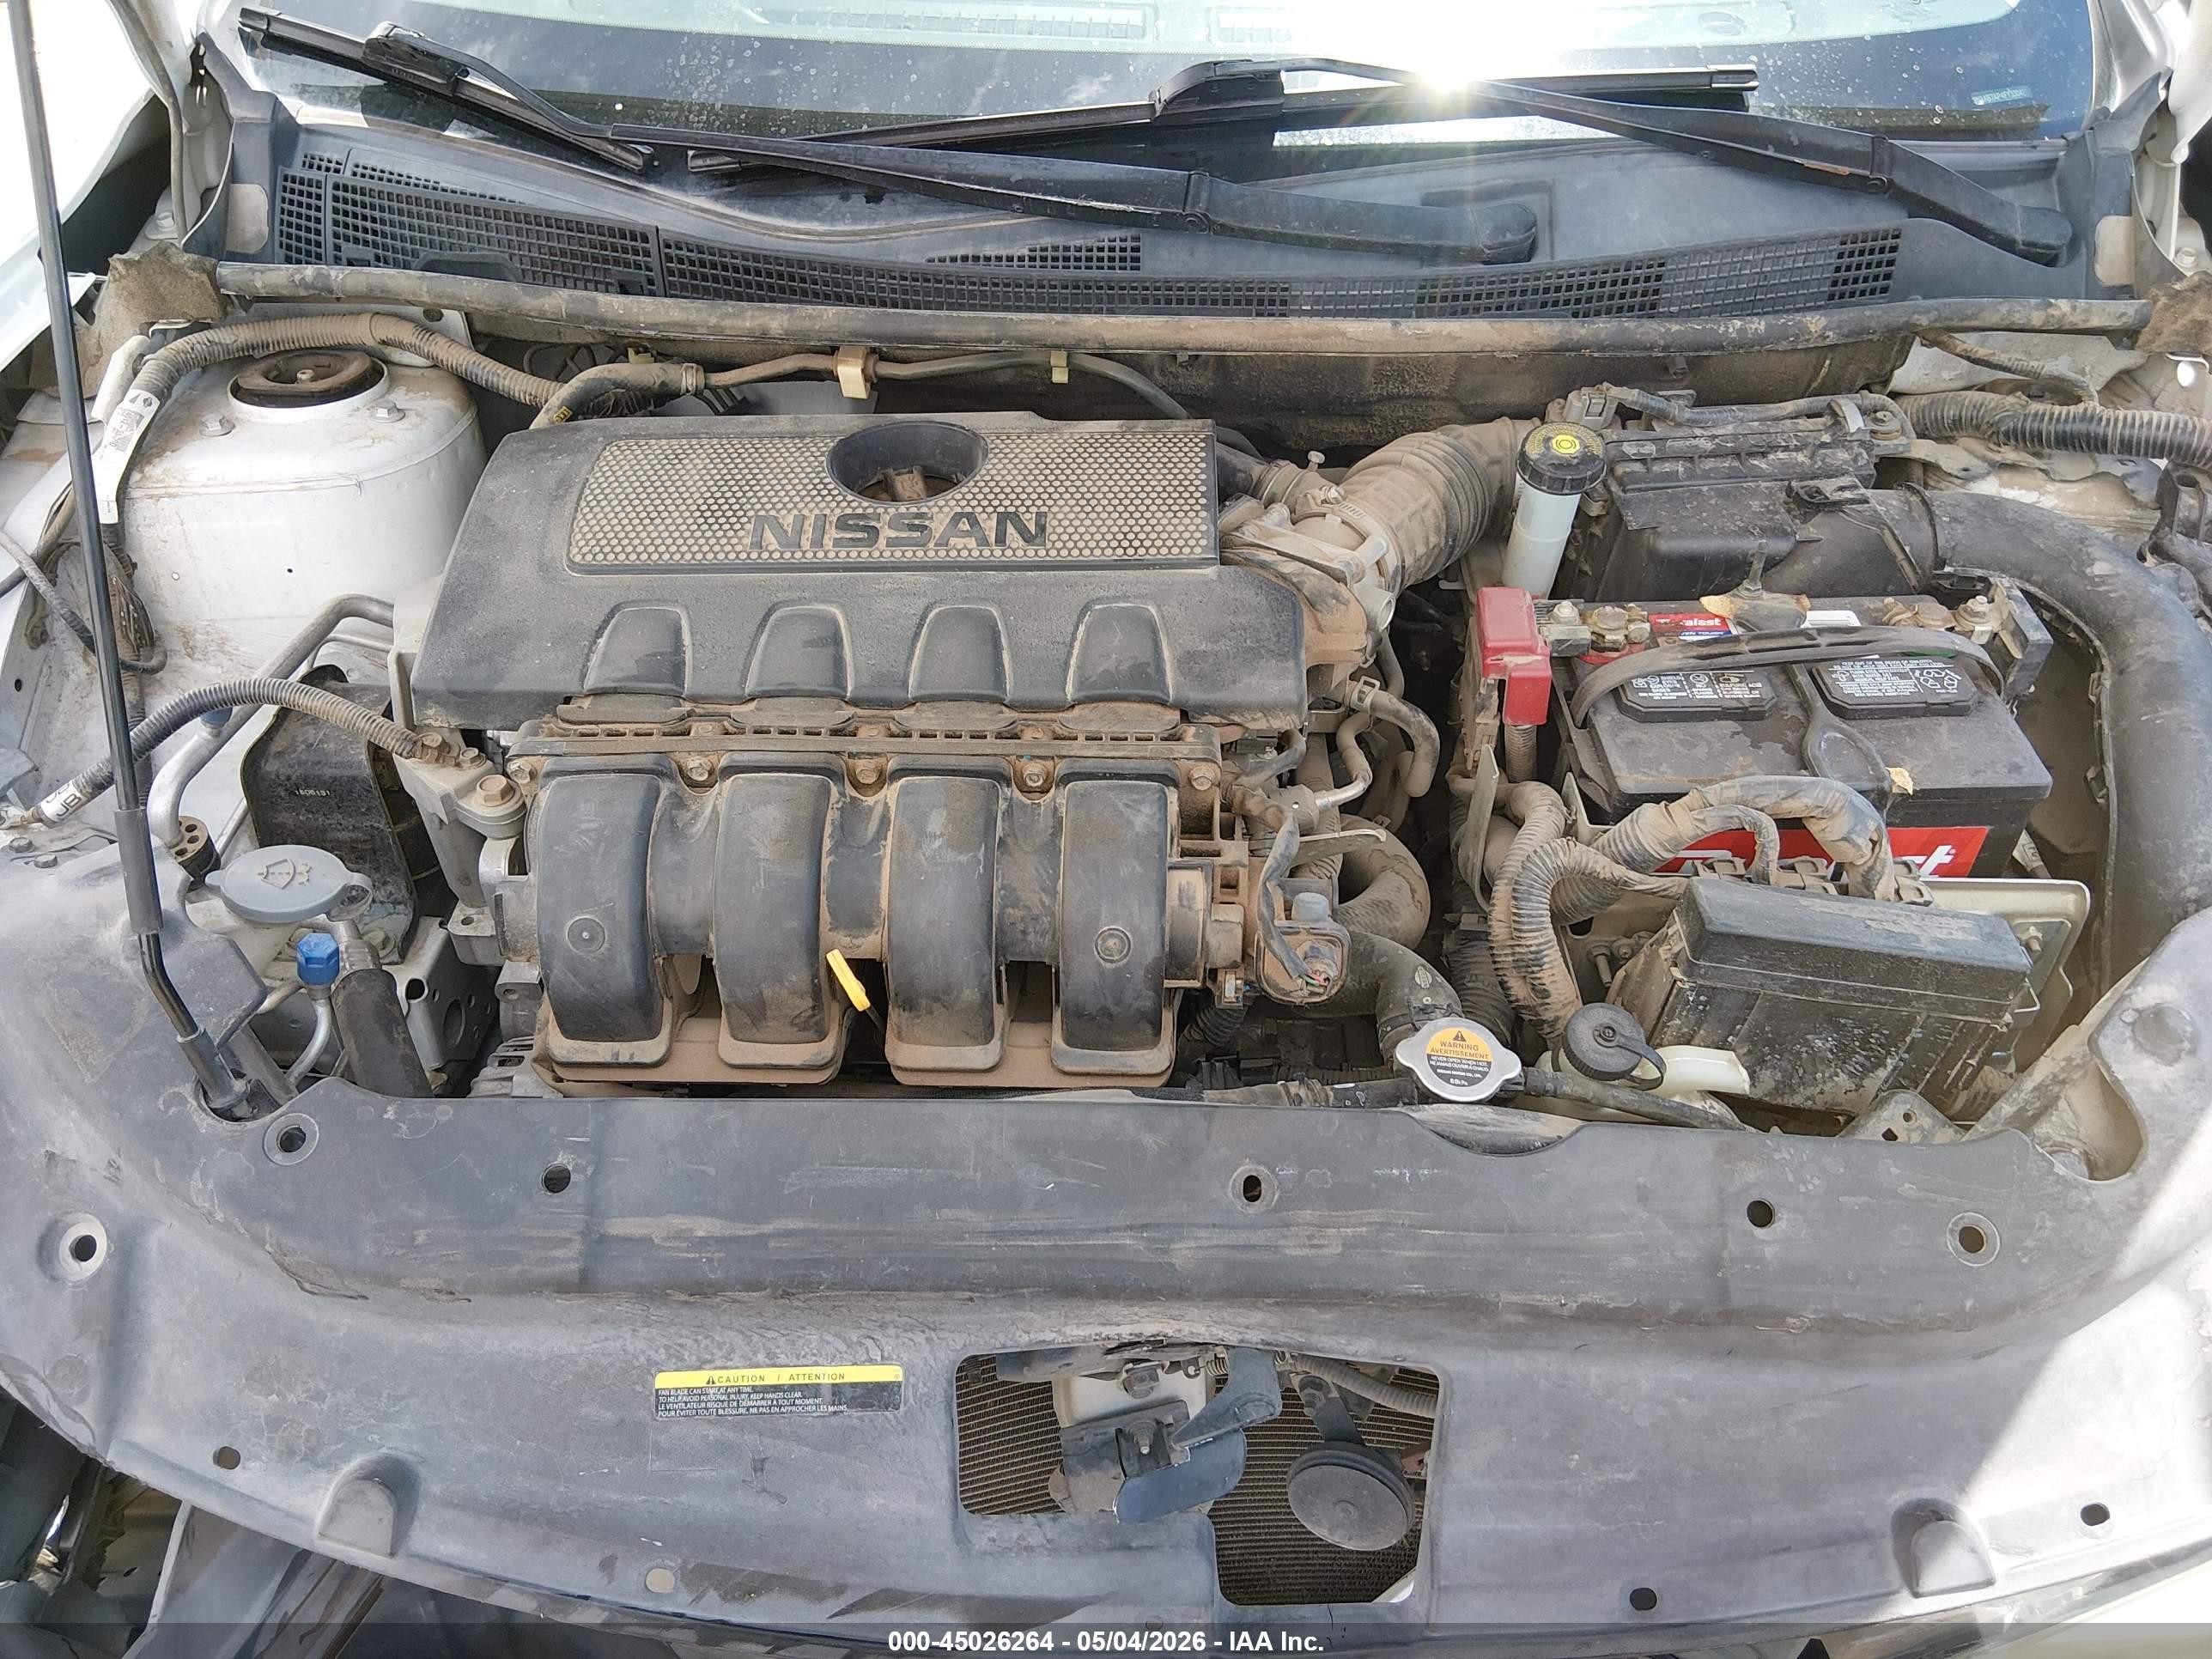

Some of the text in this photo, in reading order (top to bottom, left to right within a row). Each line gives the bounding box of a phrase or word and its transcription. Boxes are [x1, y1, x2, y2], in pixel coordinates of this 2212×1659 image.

[749, 512, 1048, 550] NISSAN
[56, 793, 82, 817] JB
[1439, 1040, 1480, 1052] WARNING
[1430, 1047, 1490, 1060] AVERTISSEMENT
[717, 1375, 765, 1383] CAUTION
[788, 1373, 845, 1382] ATTENTION
